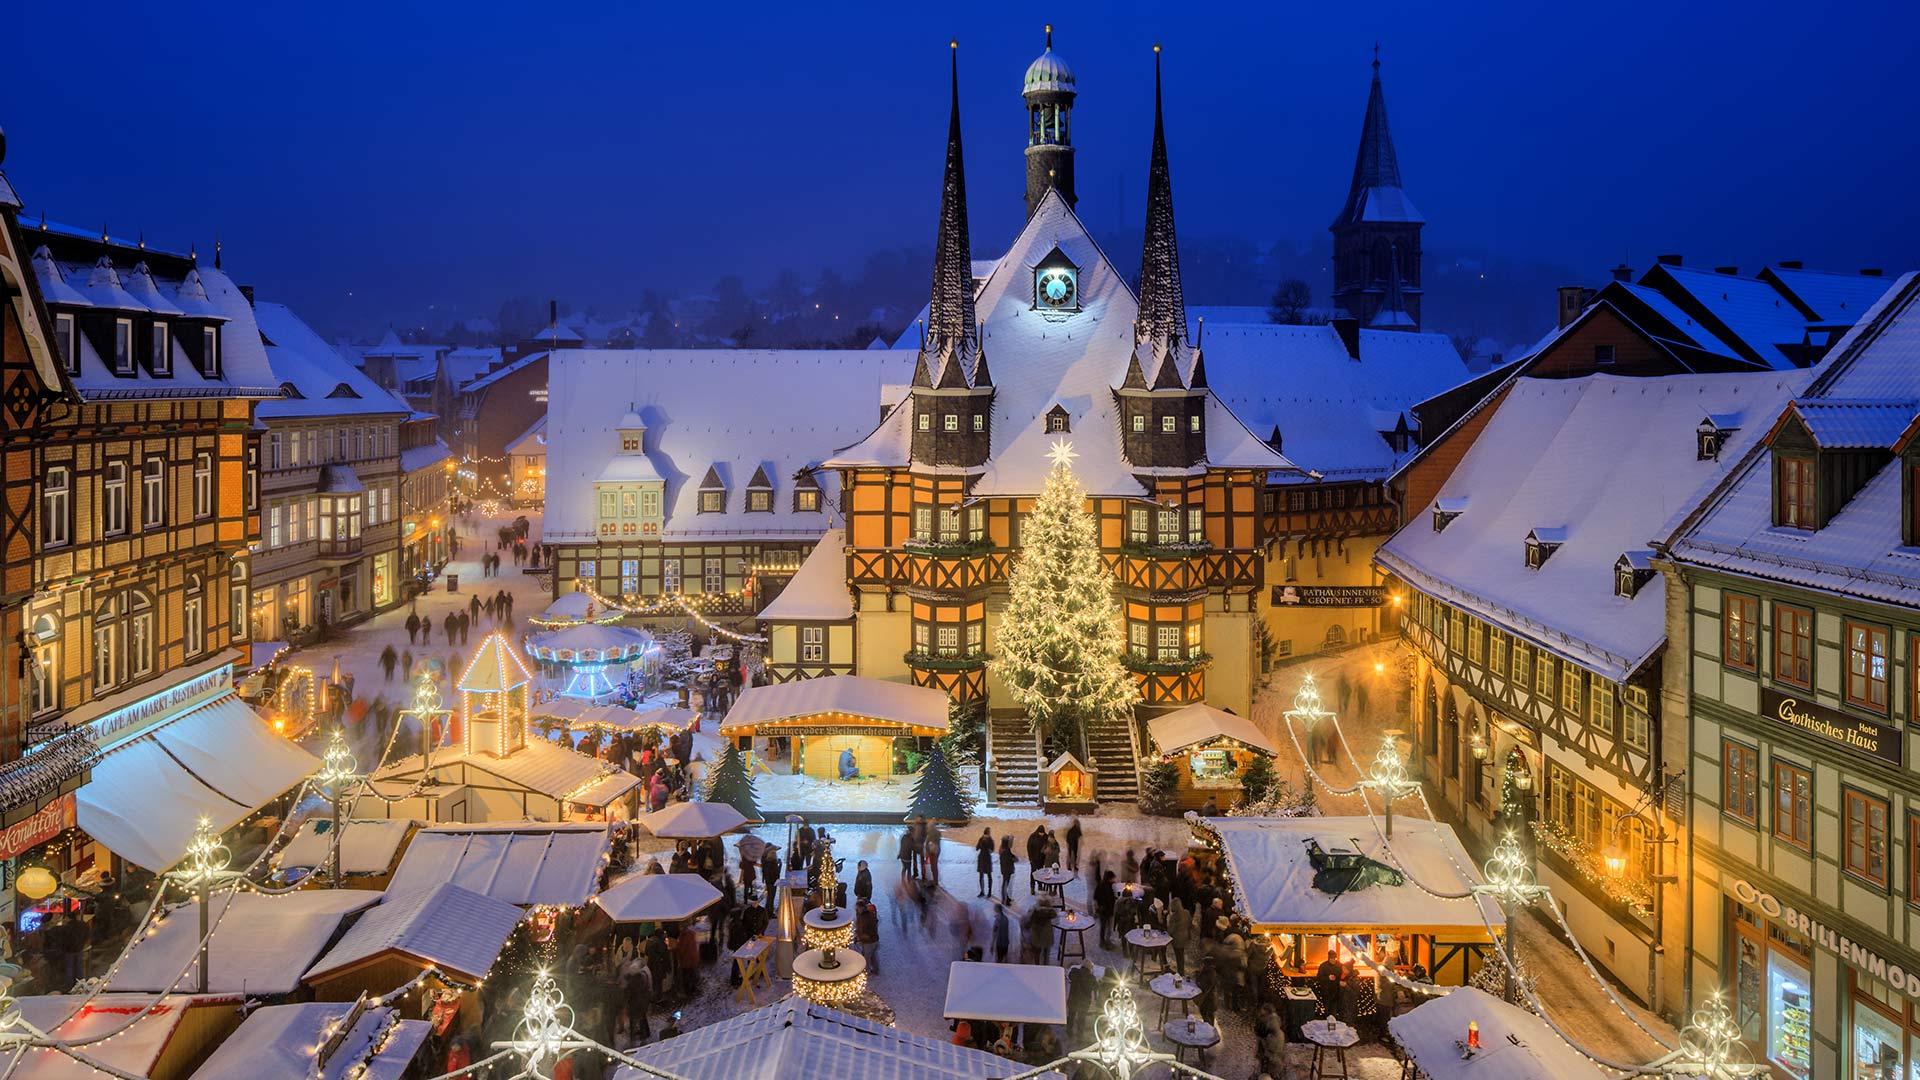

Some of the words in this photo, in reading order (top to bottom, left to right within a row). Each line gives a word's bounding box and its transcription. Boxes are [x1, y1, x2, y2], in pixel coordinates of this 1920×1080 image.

[126, 709, 141, 727] AM
[1778, 698, 1844, 740] Gothisches
[1846, 727, 1878, 752] Haus
[756, 726, 825, 736] Wernigeröder
[826, 726, 912, 736] Weihnachtsmarkt
[1859, 722, 1878, 737] Hotel
